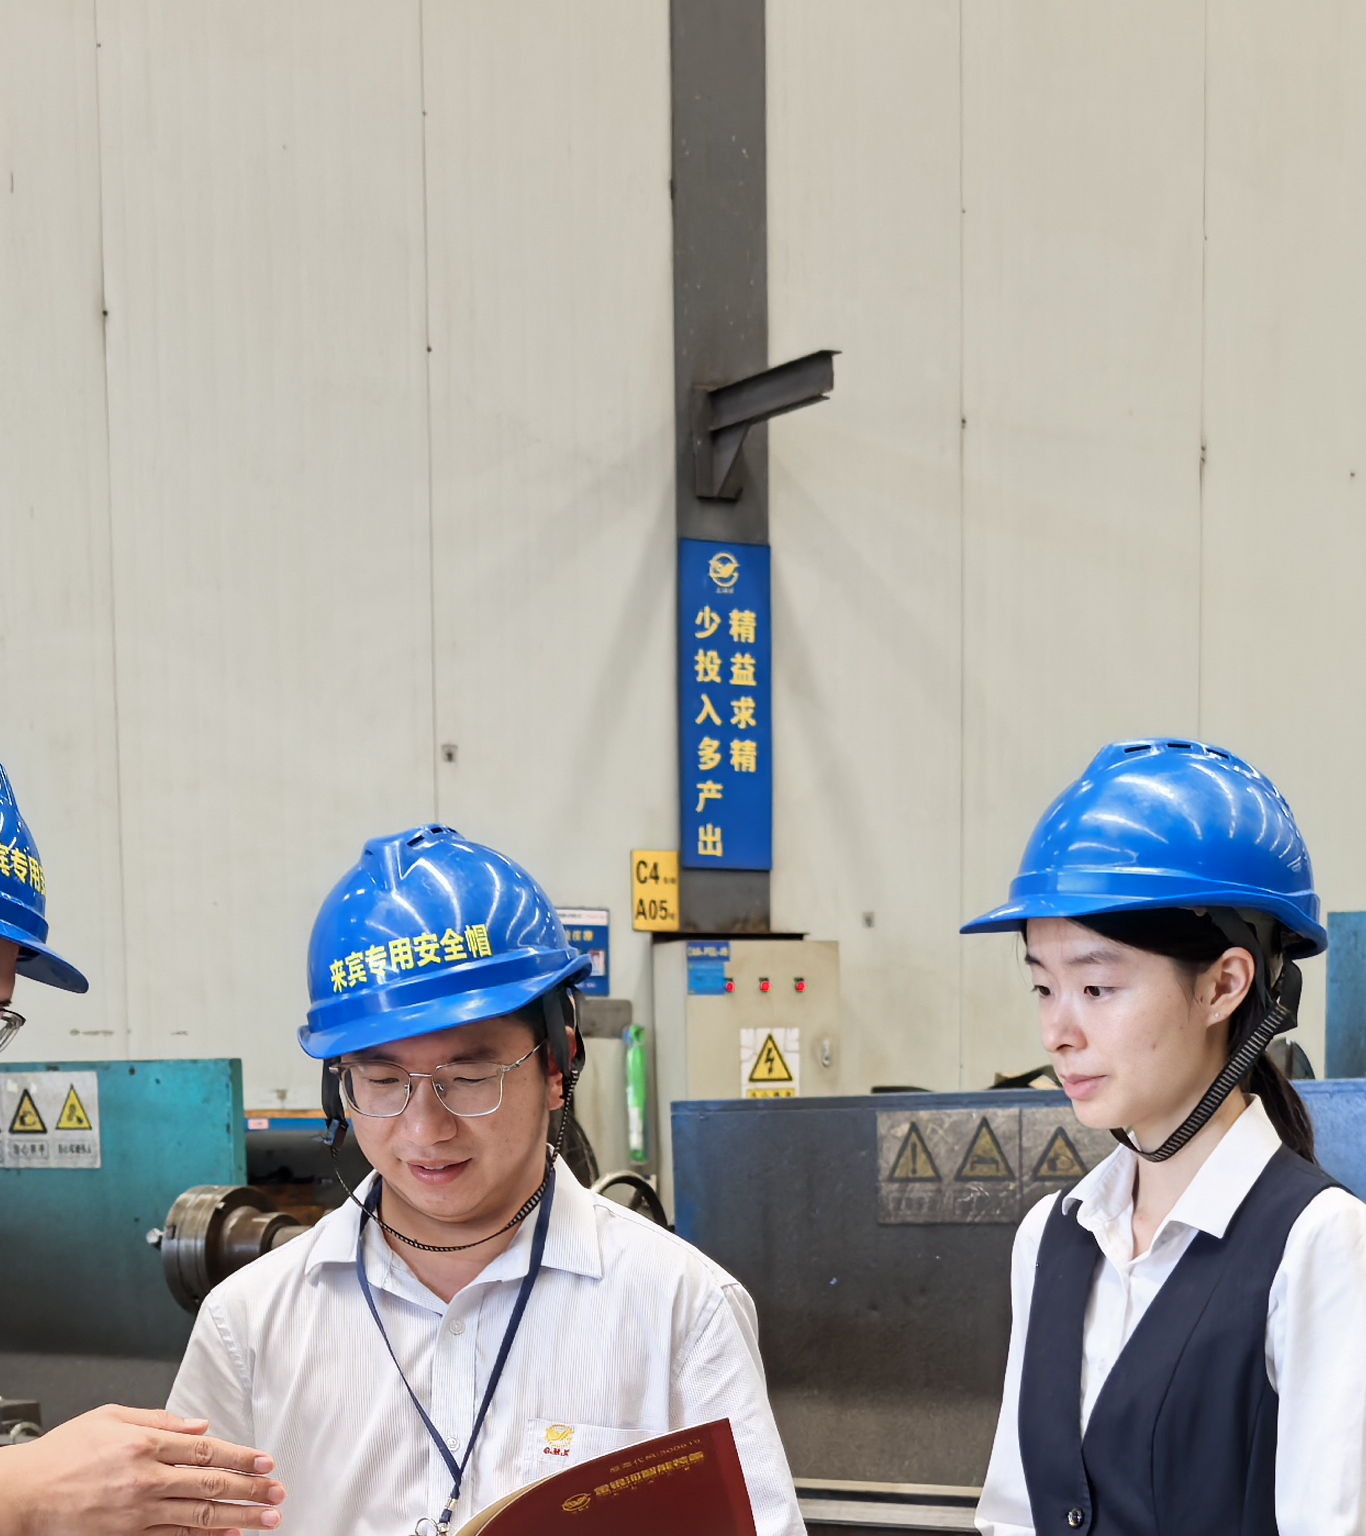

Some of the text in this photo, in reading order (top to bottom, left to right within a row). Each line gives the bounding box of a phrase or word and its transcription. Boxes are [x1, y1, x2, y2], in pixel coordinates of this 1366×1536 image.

[729, 608, 757, 773] 精益求精
[695, 606, 723, 857] 少投入多产出
[636, 860, 659, 884] C4
[635, 898, 668, 920] A05
[329, 924, 493, 993] 来宾专用安全帽
